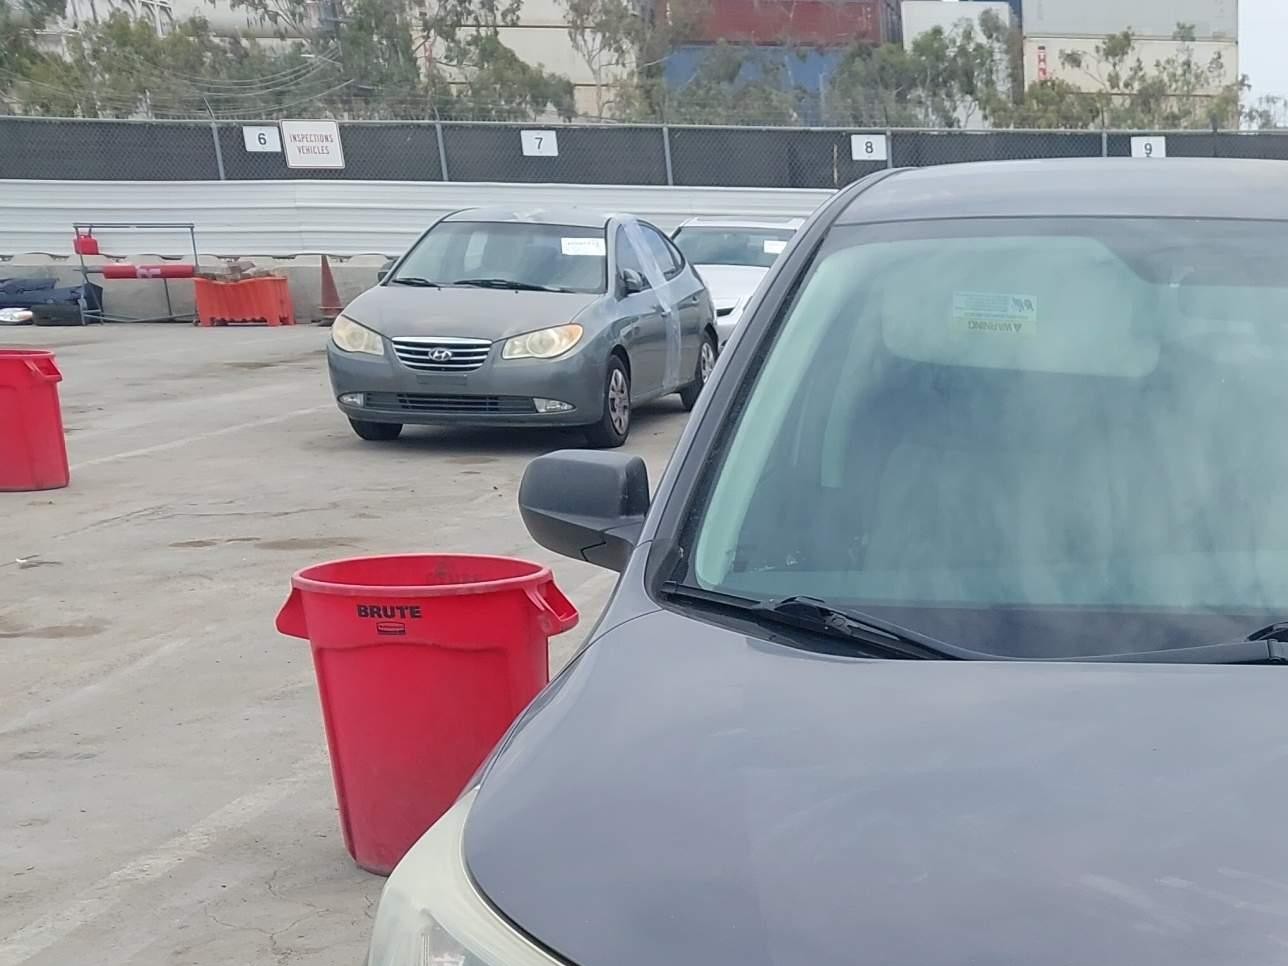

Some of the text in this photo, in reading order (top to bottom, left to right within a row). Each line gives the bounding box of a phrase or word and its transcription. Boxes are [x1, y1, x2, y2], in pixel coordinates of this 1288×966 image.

[257, 132, 267, 146] 6
[289, 133, 334, 143] INSPECTIONS
[534, 136, 544, 150] 7
[296, 145, 330, 155] VEHICLES
[864, 140, 874, 154] 8
[1144, 142, 1153, 155] 9
[356, 604, 422, 619] BRUTE
